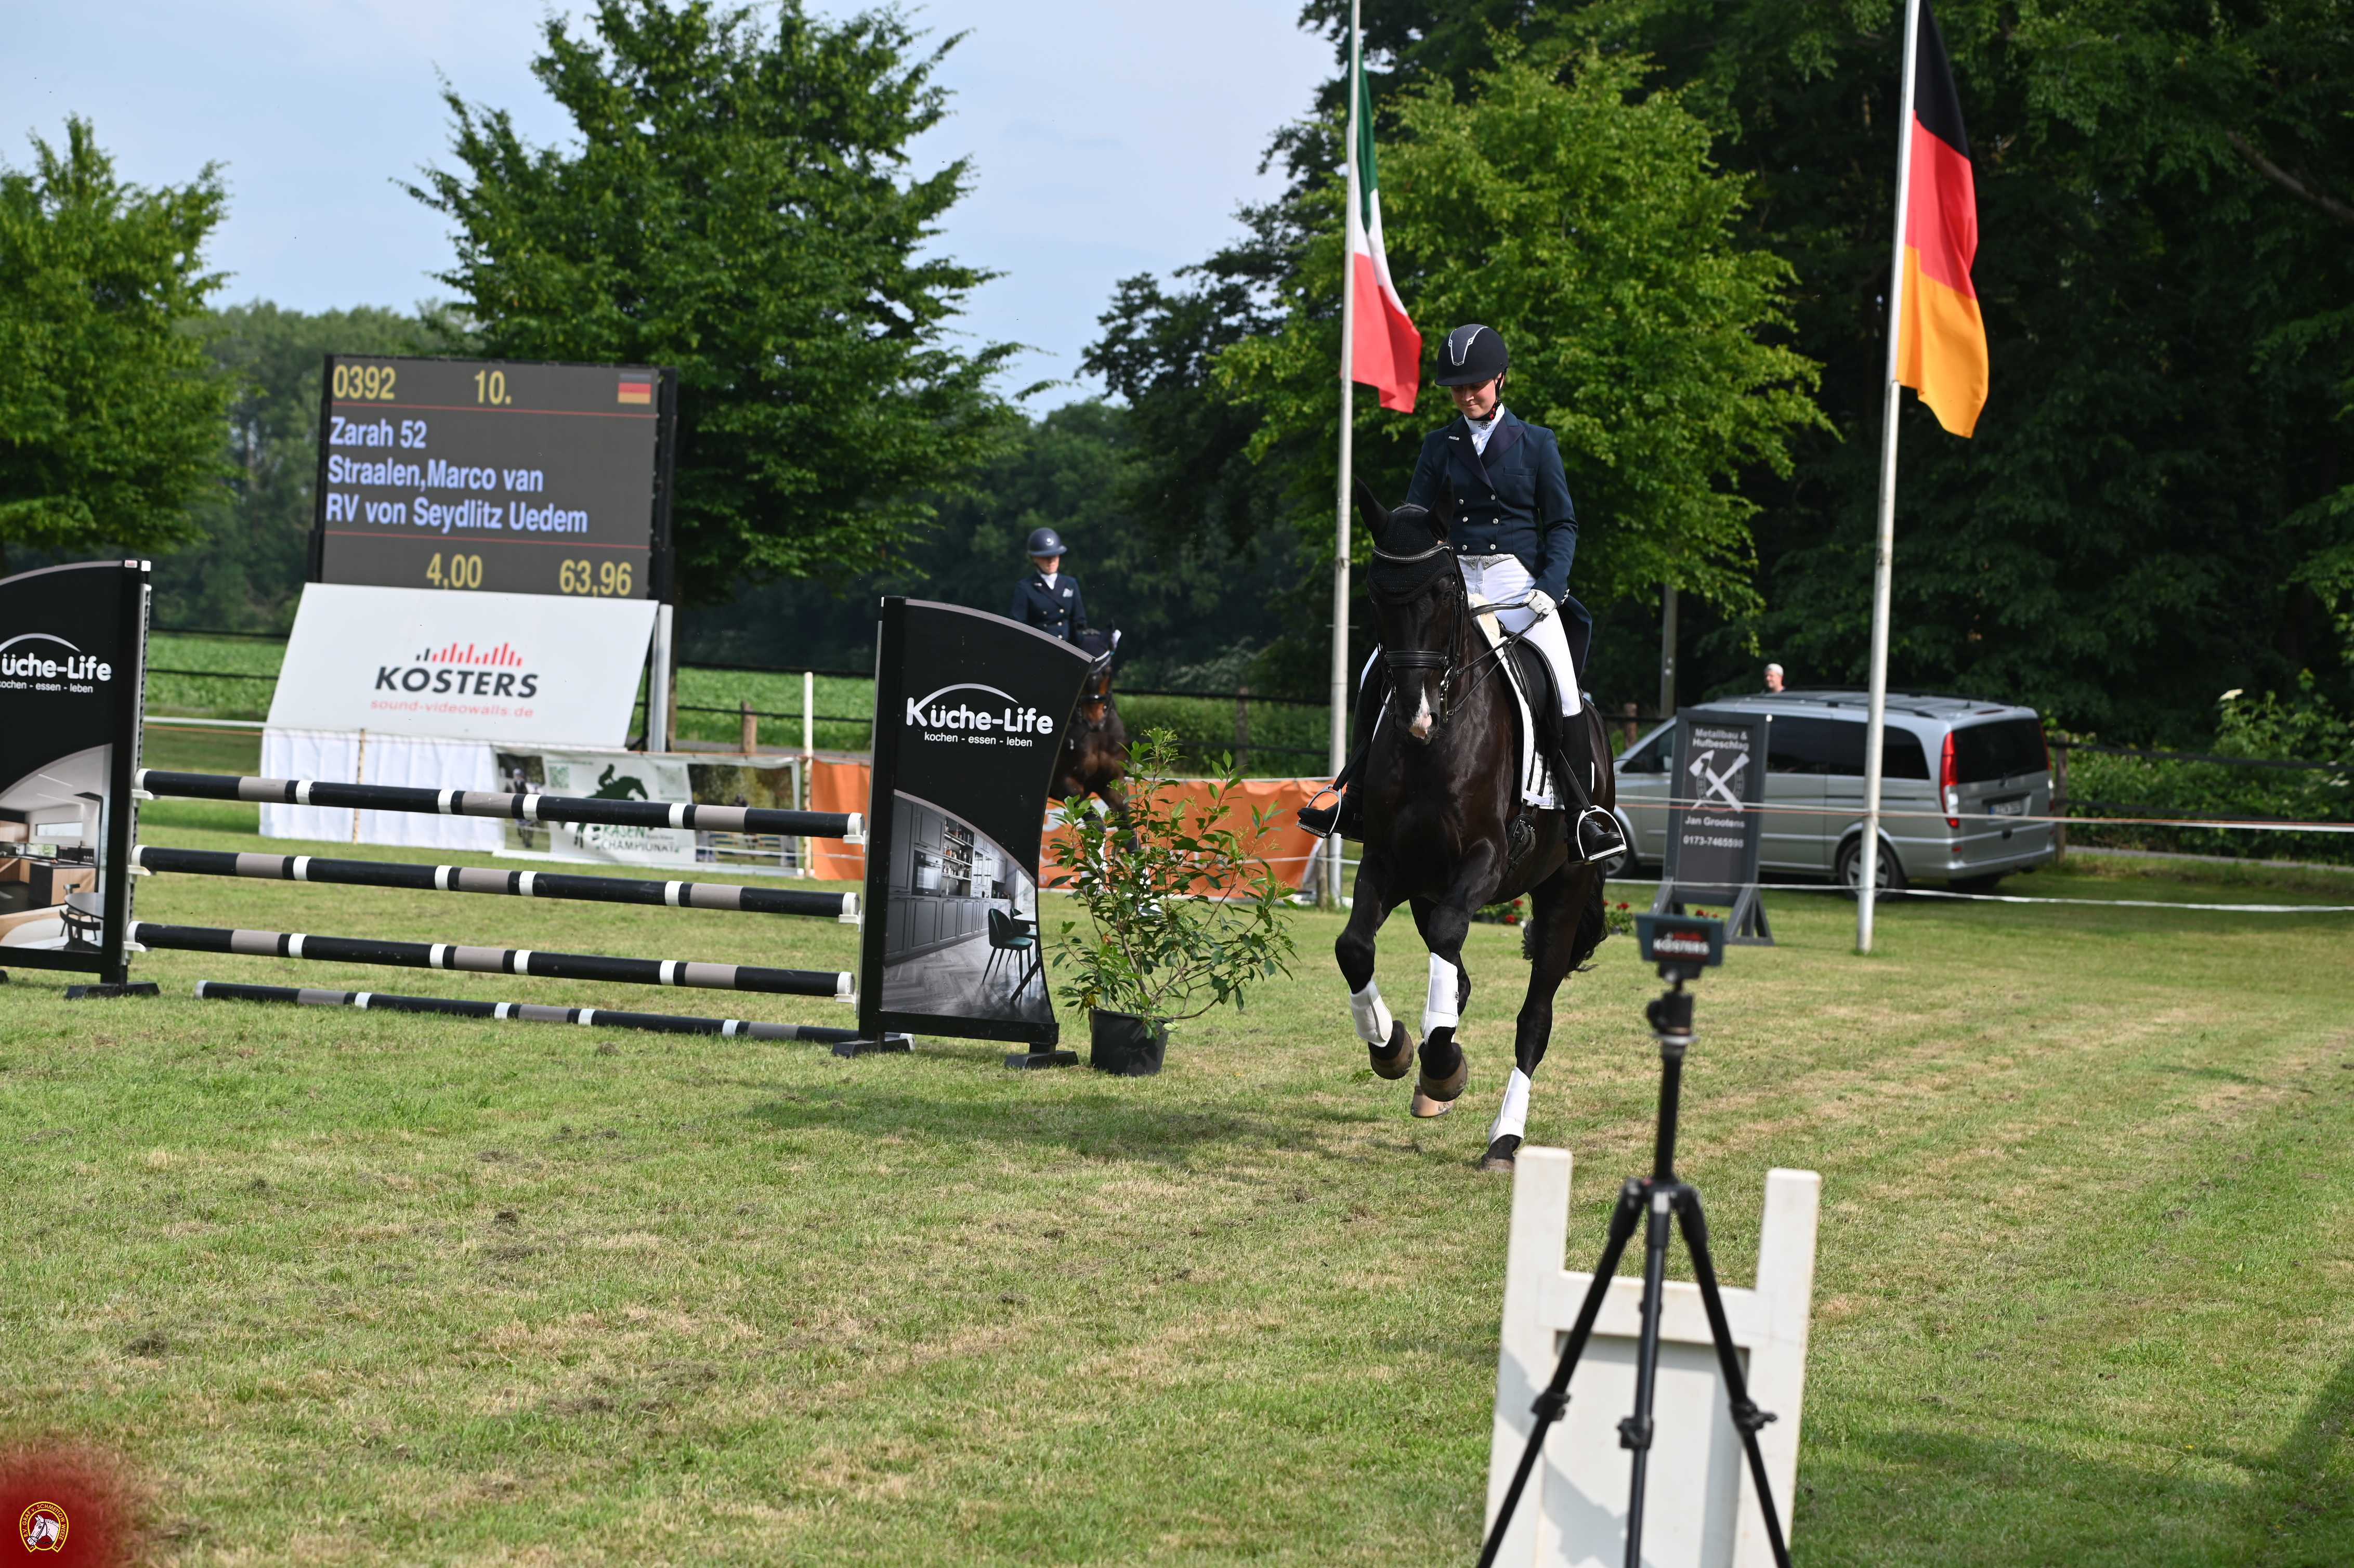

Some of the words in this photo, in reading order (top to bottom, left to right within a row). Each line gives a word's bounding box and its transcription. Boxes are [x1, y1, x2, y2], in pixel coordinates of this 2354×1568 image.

[333, 364, 396, 400] 0392
[474, 370, 512, 405] 10.
[329, 416, 393, 448] Zarah
[400, 420, 427, 449] 52
[328, 454, 496, 492] Straalen,Marco
[503, 469, 544, 492] van
[326, 493, 359, 521] RV
[365, 501, 406, 525] von
[413, 496, 503, 534] Seydlitz
[509, 501, 588, 533] Uedem
[426, 553, 483, 591] 4,00
[559, 559, 632, 598] 63,96
[0, 652, 112, 682] üche-Life
[35, 682, 61, 692] essen
[70, 683, 94, 693] leben
[906, 697, 1053, 735] Küche-Life
[924, 731, 958, 743] kochen
[968, 735, 997, 745] essen
[1006, 736, 1033, 747] leben
[1693, 737, 1750, 752] Hufbeschlag
[1695, 728, 1738, 740] Metallbau
[1740, 731, 1748, 740] &
[1684, 815, 1702, 825] Jan
[1703, 816, 1745, 828] Grootens
